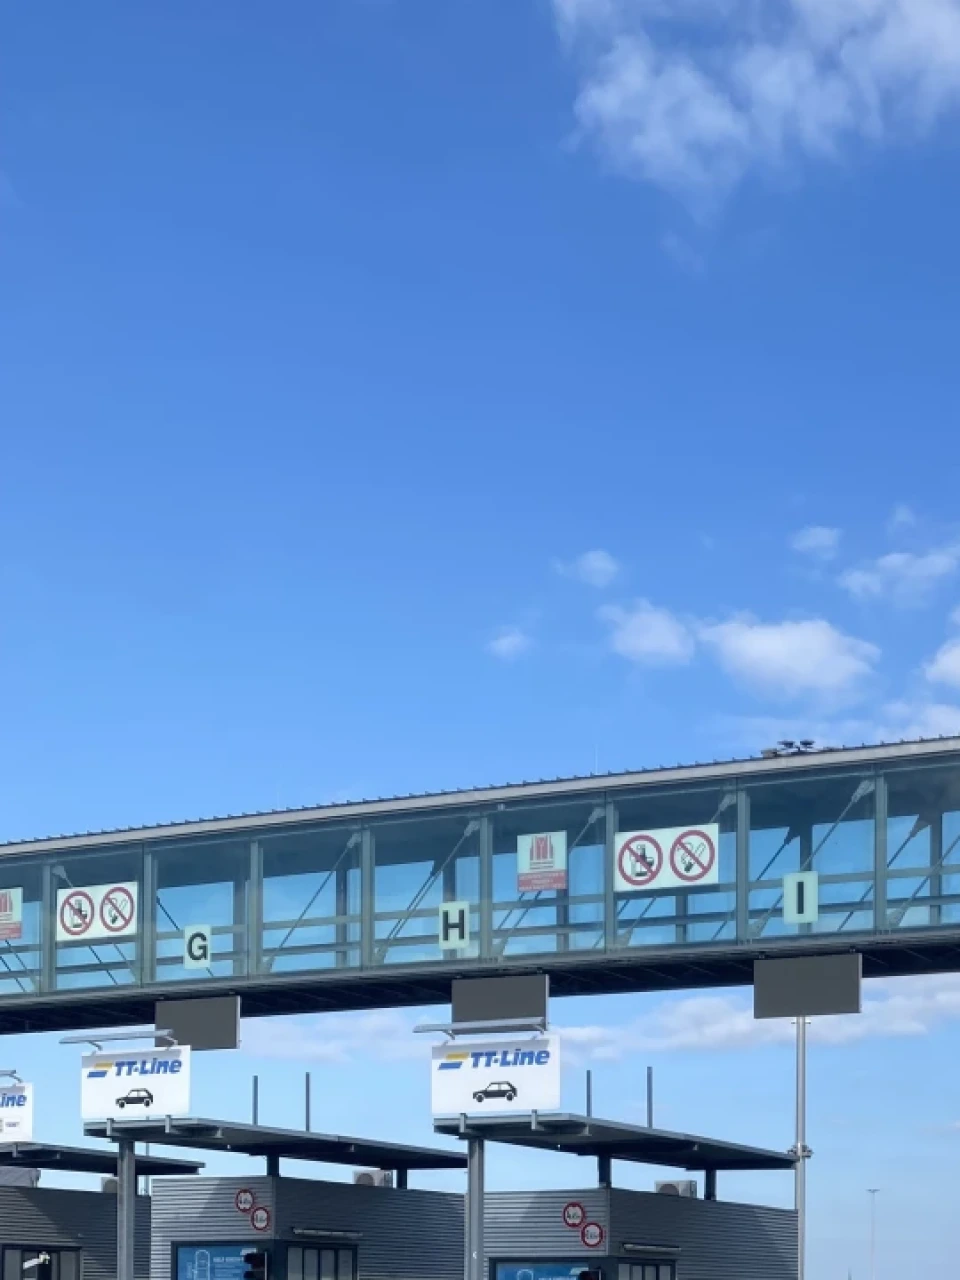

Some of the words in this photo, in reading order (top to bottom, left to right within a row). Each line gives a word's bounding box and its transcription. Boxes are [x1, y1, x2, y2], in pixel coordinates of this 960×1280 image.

[796, 881, 804, 914] I
[442, 909, 465, 941] H
[187, 931, 208, 961] G
[115, 1057, 182, 1076] TT-Line
[470, 1048, 550, 1068] TT-Line
[0, 1092, 27, 1108] ine
